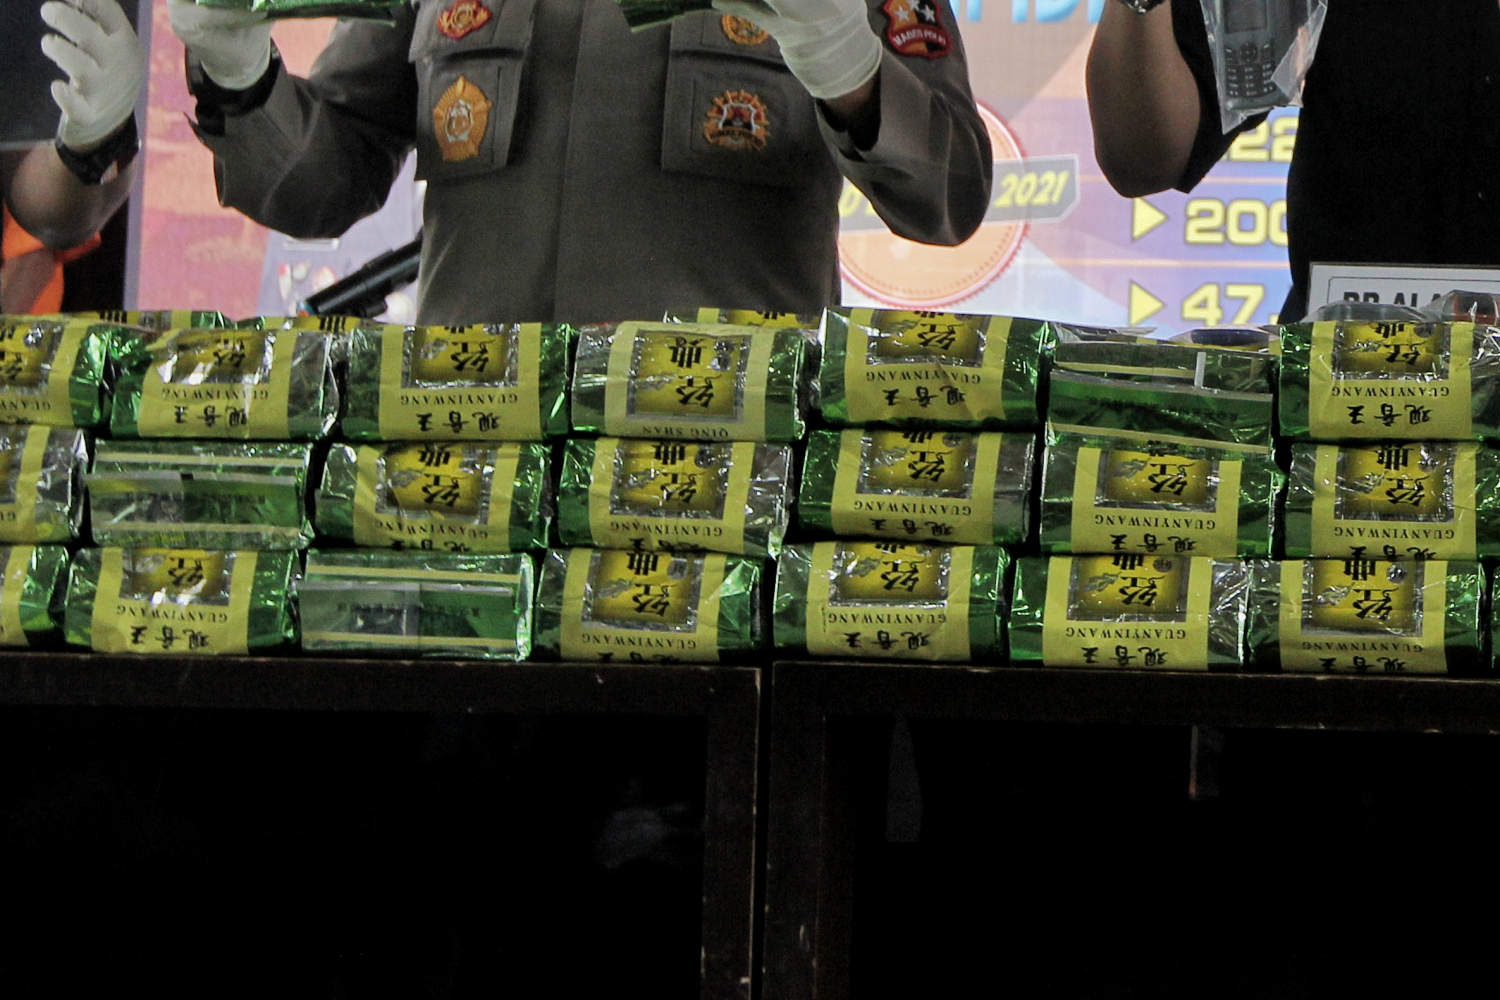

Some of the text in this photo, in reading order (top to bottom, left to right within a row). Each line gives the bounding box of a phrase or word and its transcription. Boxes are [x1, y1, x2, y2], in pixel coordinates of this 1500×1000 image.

[993, 170, 1070, 209] 2021
[866, 371, 982, 384] GUANYINWANG
[1331, 386, 1450, 398] GUANYINWANG
[400, 393, 518, 406] GUANYINWANG
[853, 500, 972, 516] GUANYINWANG
[1094, 513, 1217, 530] GUANYINWANG
[1334, 526, 1455, 539] GUANYINWANG
[828, 613, 947, 624] GUANYINWANG
[1065, 627, 1187, 640] GUANYINWANG
[582, 633, 697, 649] GUANYINWANG
